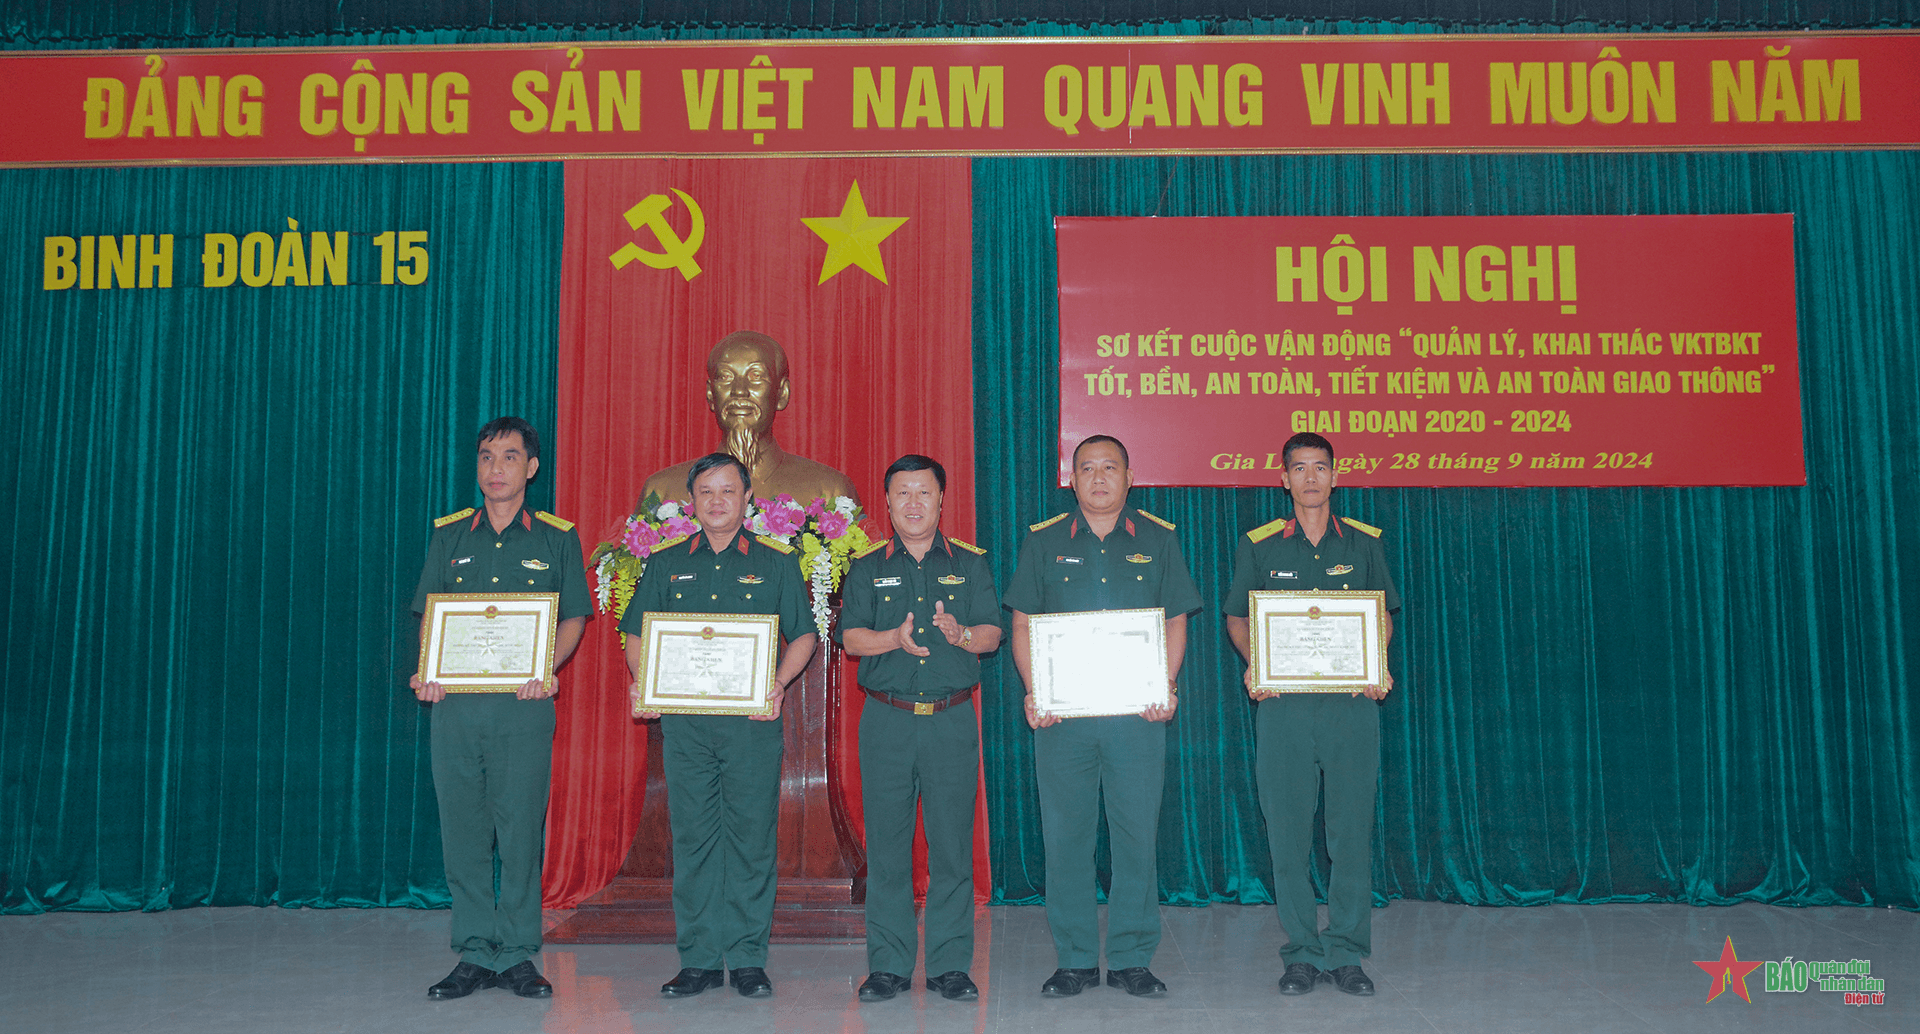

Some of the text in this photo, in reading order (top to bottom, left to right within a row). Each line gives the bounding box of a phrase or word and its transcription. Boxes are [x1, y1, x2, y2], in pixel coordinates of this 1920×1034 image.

[83, 45, 1862, 152] ĐẢNG CỘNG SẢN VIỆT NAM QUANG VINH MUÔN NĂM
[43, 217, 429, 291] BINH ĐOÀN 15
[1275, 233, 1578, 316] HỘI NGHỊ
[1096, 332, 1131, 358] SƠ
[1137, 327, 1183, 357] KẾT
[1190, 329, 1257, 361] CUỘC
[1264, 329, 1315, 361] VẬN
[1322, 329, 1391, 361] ĐỘNG
[1489, 328, 1525, 358] LÝ,
[1532, 332, 1591, 355] KHAI
[1598, 328, 1663, 355] THÁC
[1669, 332, 1763, 355] VKTBKT
[1084, 365, 1132, 398] TỐT,
[1140, 365, 1198, 398] BỀN,
[1205, 372, 1241, 395] AN
[1247, 368, 1322, 398] TOÀN,
[1328, 365, 1380, 395] TIẾT
[1386, 366, 1450, 399] KIỆM
[1457, 366, 1491, 394] VÀ
[1497, 371, 1533, 394] AN
[1539, 366, 1606, 394] TOÀN
[1613, 370, 1671, 394] GIAO
[1291, 410, 1341, 433] GIAI
[1348, 410, 1418, 438] ĐOẠN
[1425, 410, 1486, 433] 2020
[1511, 409, 1572, 433] 2024
[1210, 453, 1255, 470] Gia
[1389, 452, 1421, 470] 28
[1428, 452, 1501, 474] tháng
[1508, 452, 1523, 469] 9
[1529, 452, 1585, 470] năm
[1593, 452, 1654, 470] 2024
